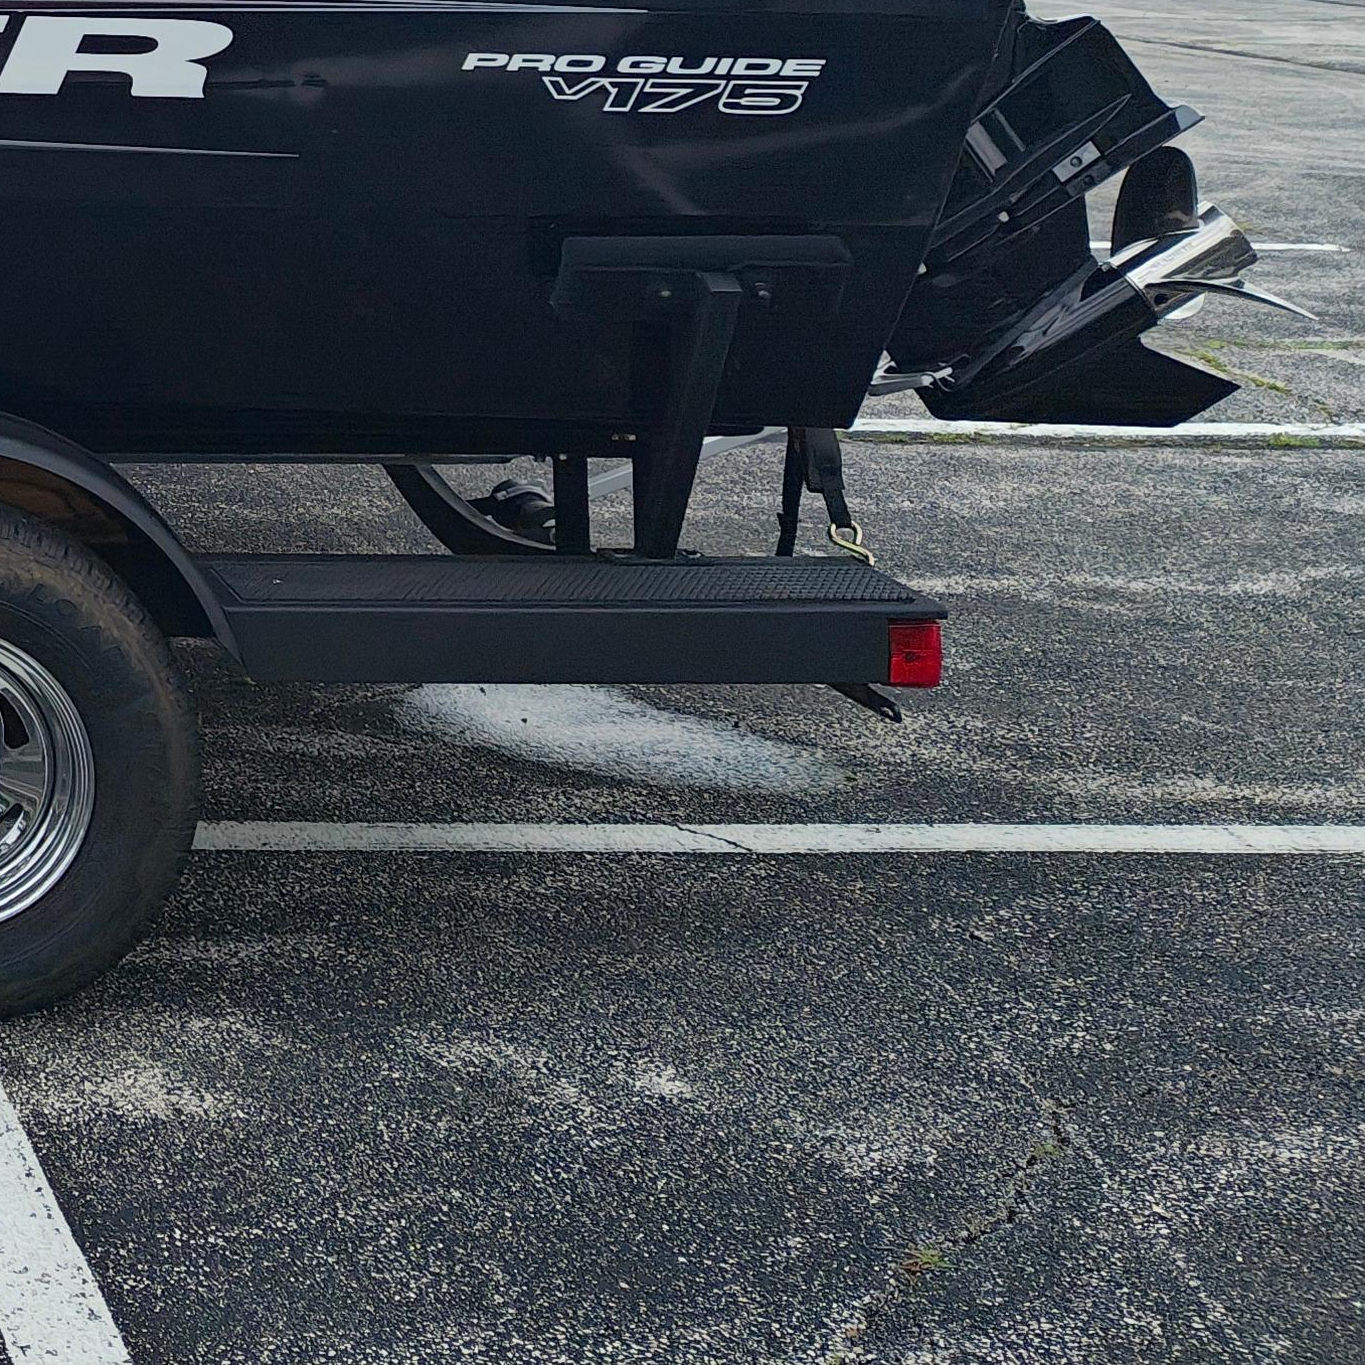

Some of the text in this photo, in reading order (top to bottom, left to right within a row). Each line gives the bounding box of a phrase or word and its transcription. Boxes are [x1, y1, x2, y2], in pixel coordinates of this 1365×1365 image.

[461, 52, 827, 77] PRO GUIDE
[541, 76, 809, 115] V175
